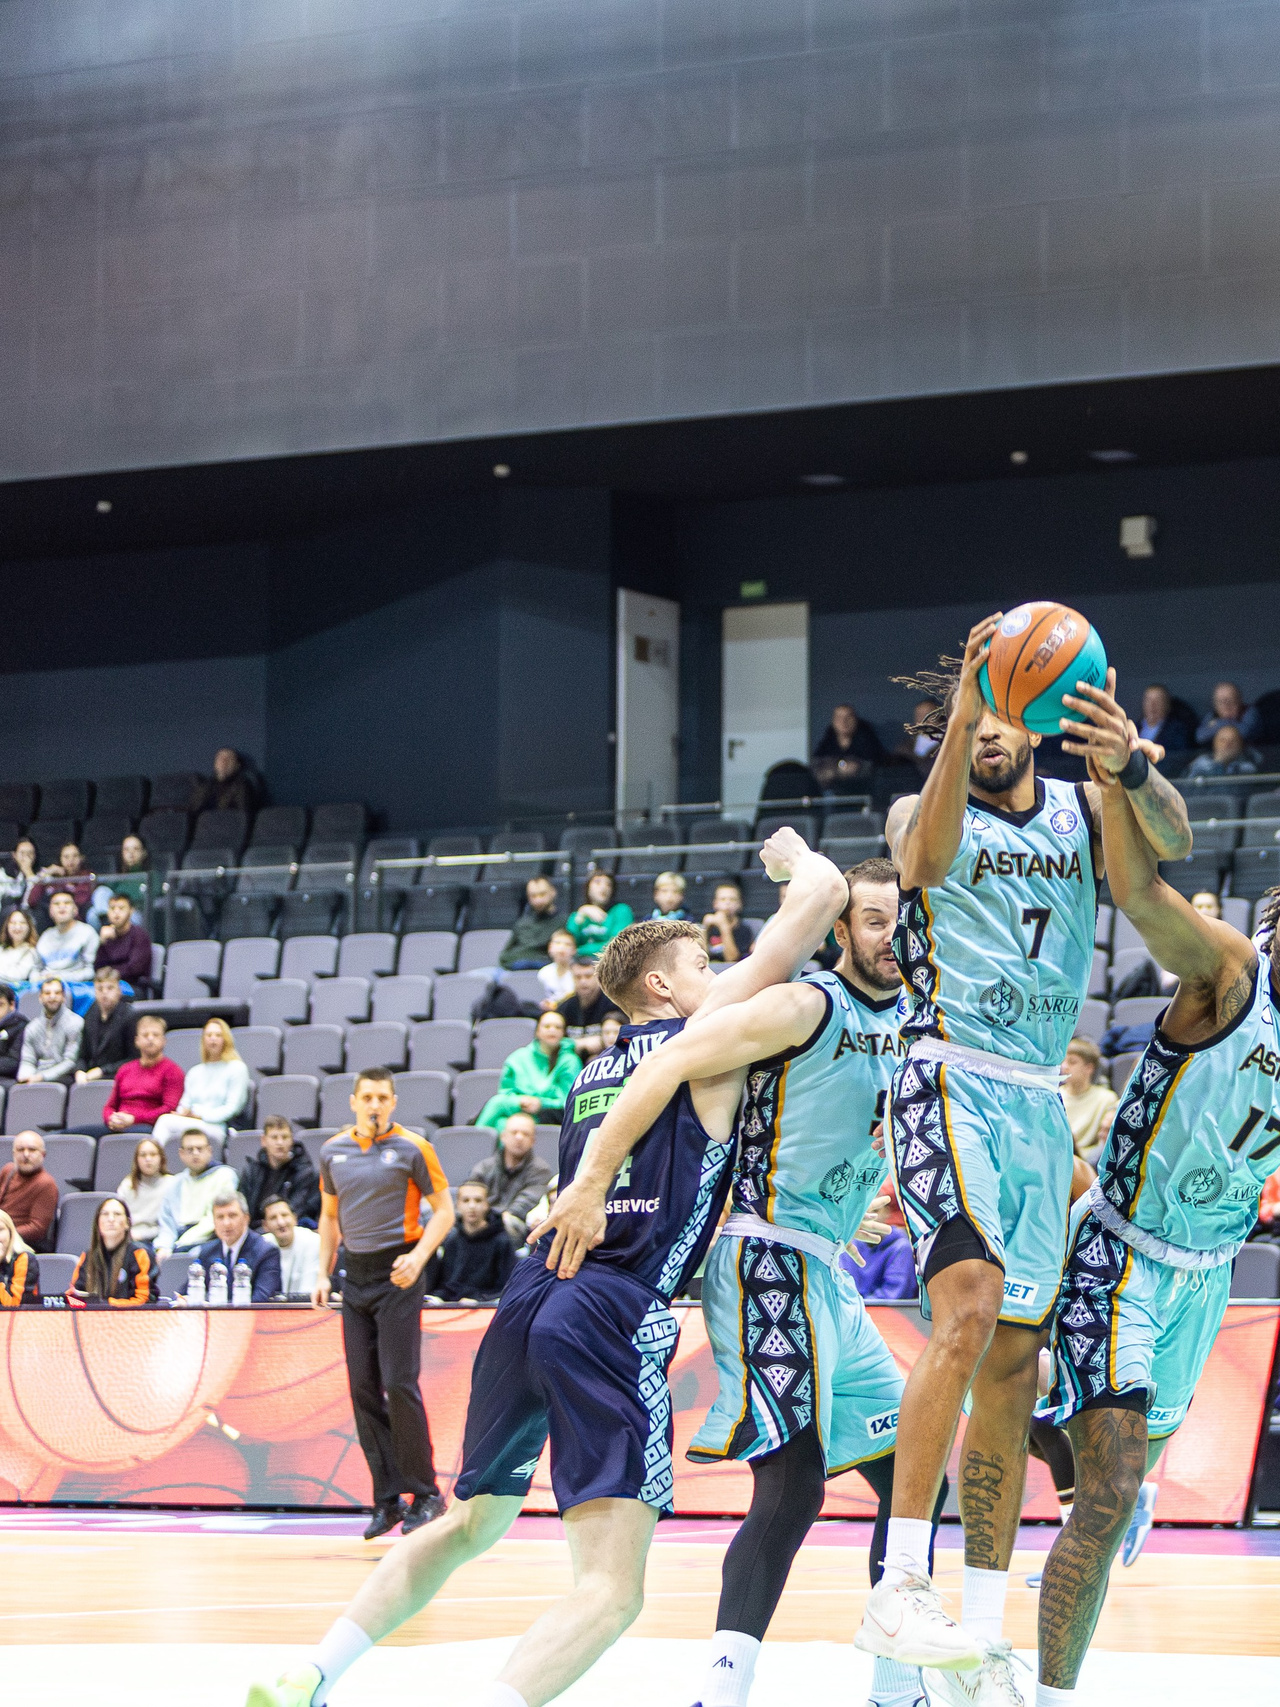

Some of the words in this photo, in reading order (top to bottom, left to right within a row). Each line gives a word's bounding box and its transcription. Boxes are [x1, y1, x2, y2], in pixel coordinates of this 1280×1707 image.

[970, 848, 1083, 886] ASTANA
[1021, 907, 1052, 959] 7
[832, 1028, 909, 1061] ASTAN
[605, 1197, 660, 1214] SERVICE
